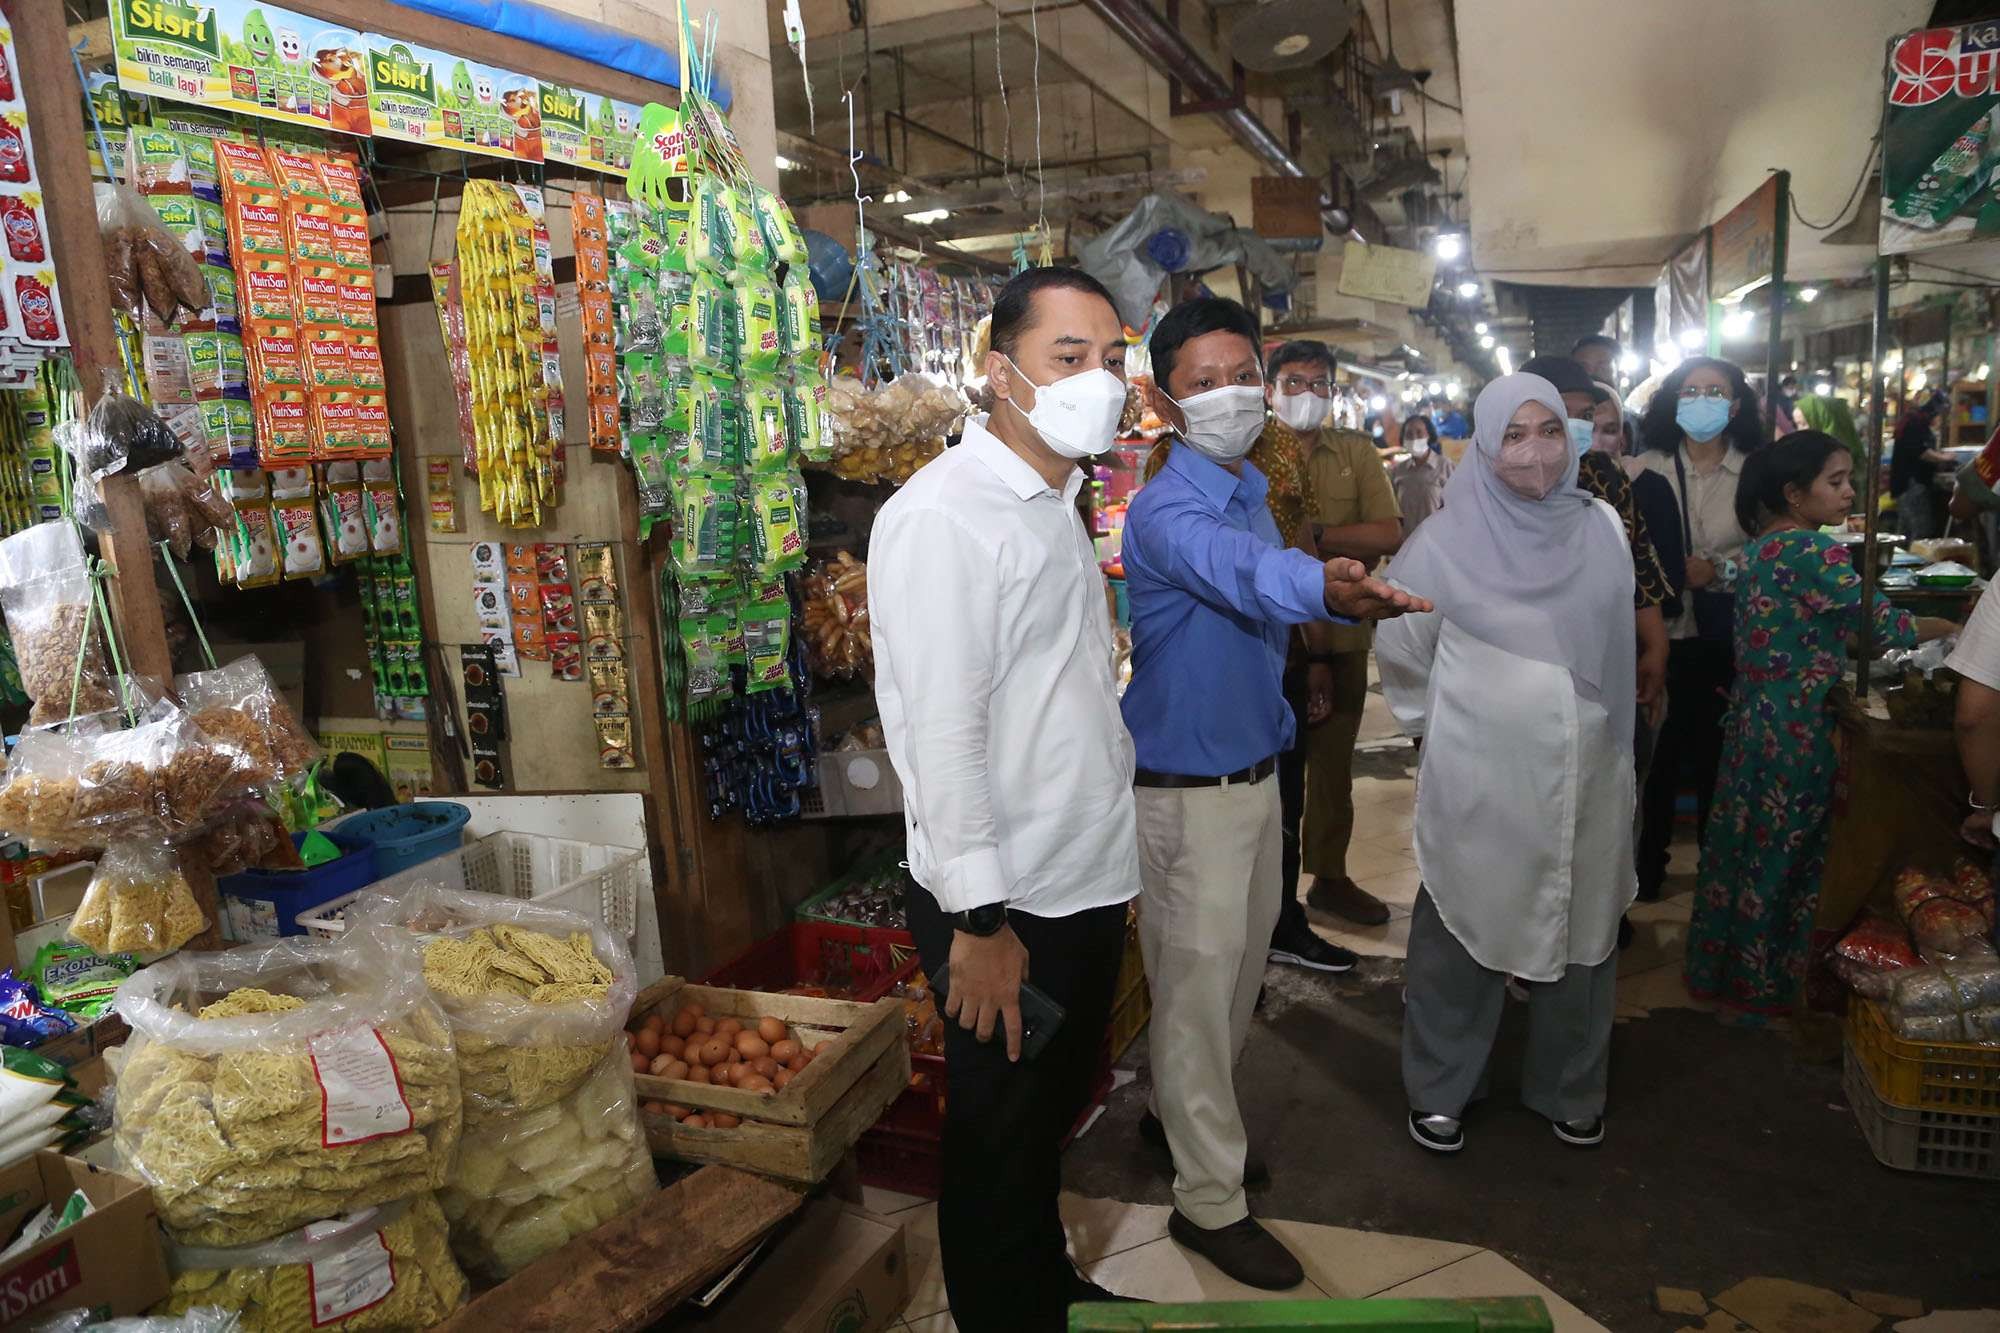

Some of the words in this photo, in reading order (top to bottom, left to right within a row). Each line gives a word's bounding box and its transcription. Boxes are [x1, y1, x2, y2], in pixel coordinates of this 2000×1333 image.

[130, 0, 207, 42] Sisri
[136, 47, 161, 66] bikin
[163, 54, 211, 74] semangat
[395, 51, 410, 64] Teh
[148, 67, 174, 87] balik
[177, 76, 197, 96] lagi
[376, 61, 427, 92] Sisri
[381, 100, 398, 113] bikin
[398, 105, 430, 117] semangat
[543, 94, 580, 121] Sisri
[168, 119, 189, 132] bikin
[190, 122, 228, 138] semangat
[407, 121, 421, 137] lagi
[737, 309, 745, 340] Standar
[790, 305, 799, 337] Standar
[746, 413, 756, 444] Standar
[798, 404, 807, 435] Standar
[279, 510, 297, 522] Good
[297, 510, 313, 522] Day
[687, 509, 695, 541] Standar
[755, 517, 766, 547] Standar
